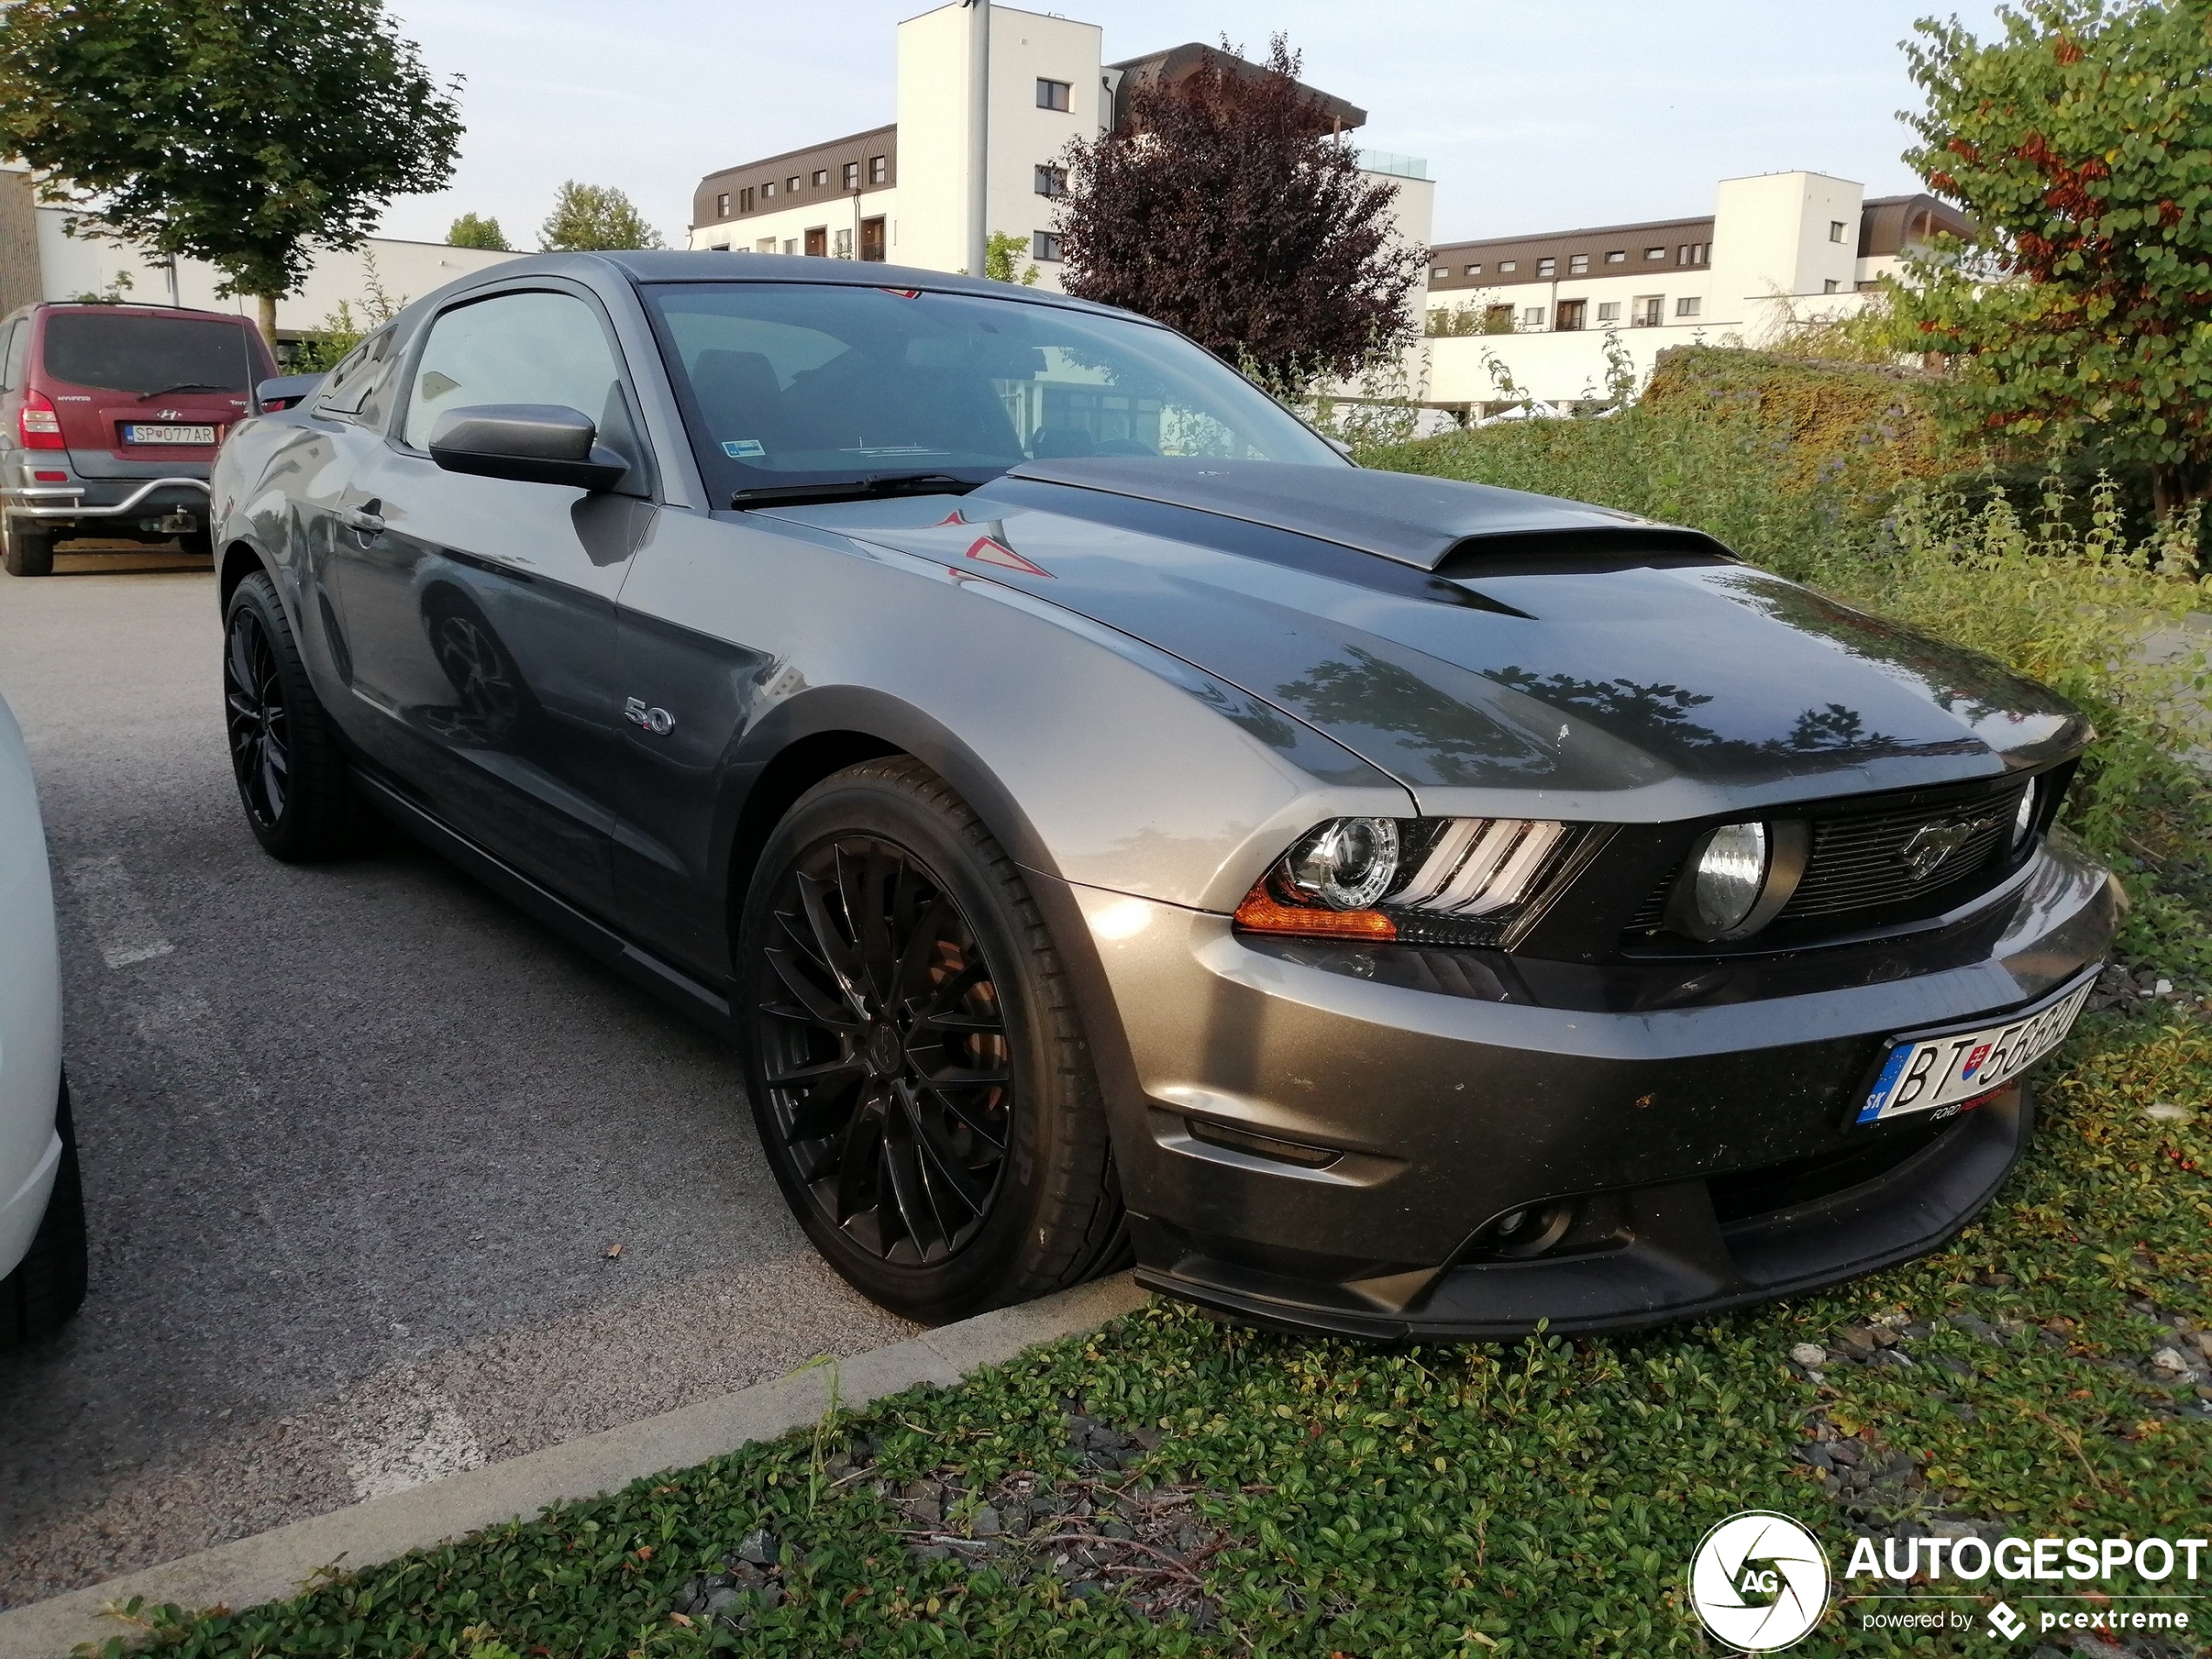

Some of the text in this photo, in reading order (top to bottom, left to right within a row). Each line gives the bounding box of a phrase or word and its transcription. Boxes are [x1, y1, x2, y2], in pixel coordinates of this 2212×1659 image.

[136, 427, 212, 442] SP 077AR
[624, 696, 676, 736] 5.0
[1891, 1037, 1977, 1109] BT
[1863, 1091, 1885, 1110] SK
[1929, 1103, 1961, 1121] FORD
